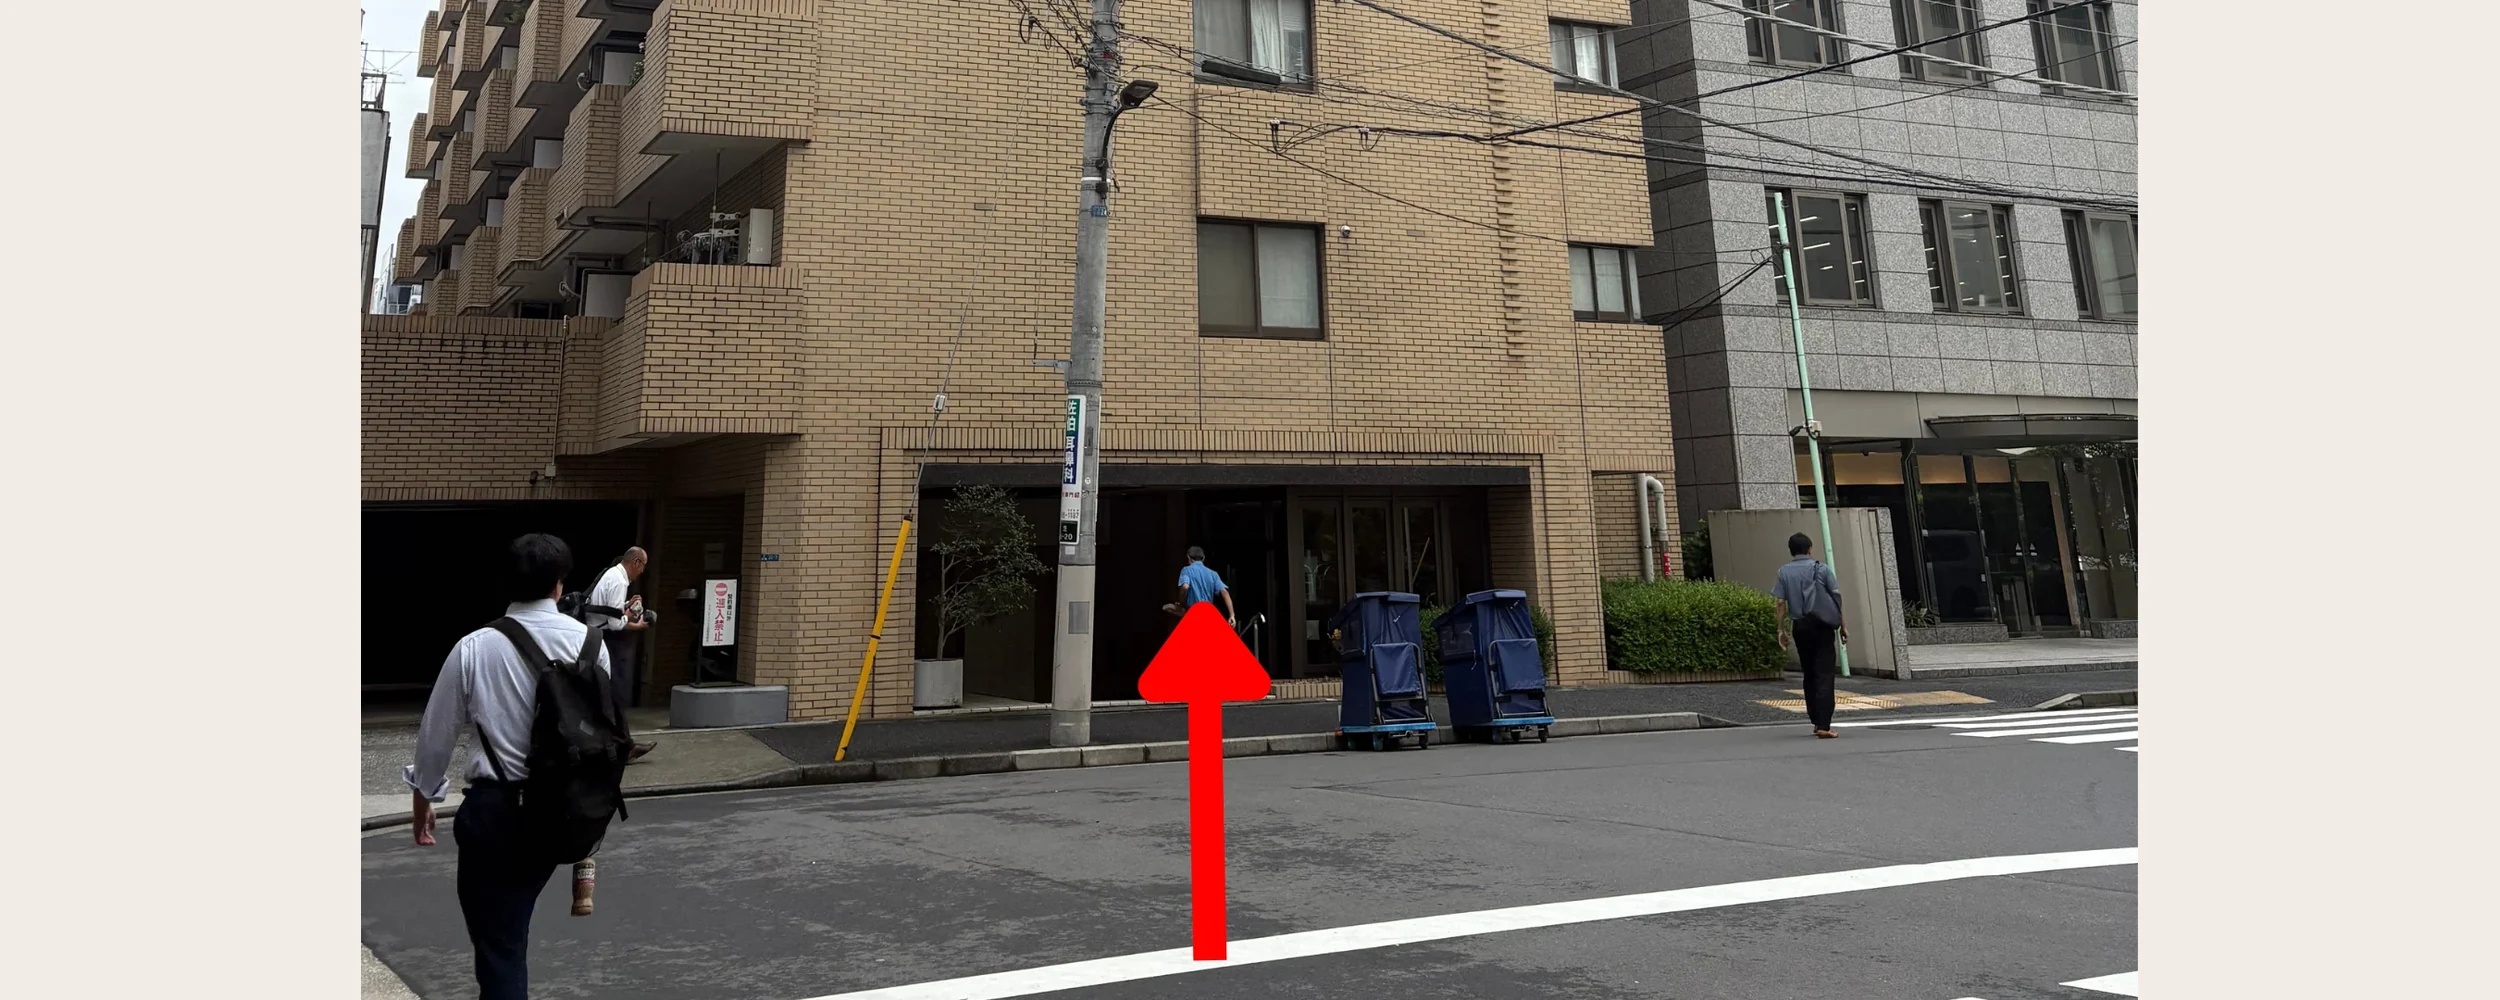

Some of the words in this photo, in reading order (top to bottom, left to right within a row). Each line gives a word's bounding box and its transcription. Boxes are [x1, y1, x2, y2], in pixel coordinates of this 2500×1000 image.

[1067, 400, 1077, 431] 佐伯
[1063, 436, 1075, 484] 耳鼻科
[714, 597, 725, 642] 進入禁止
